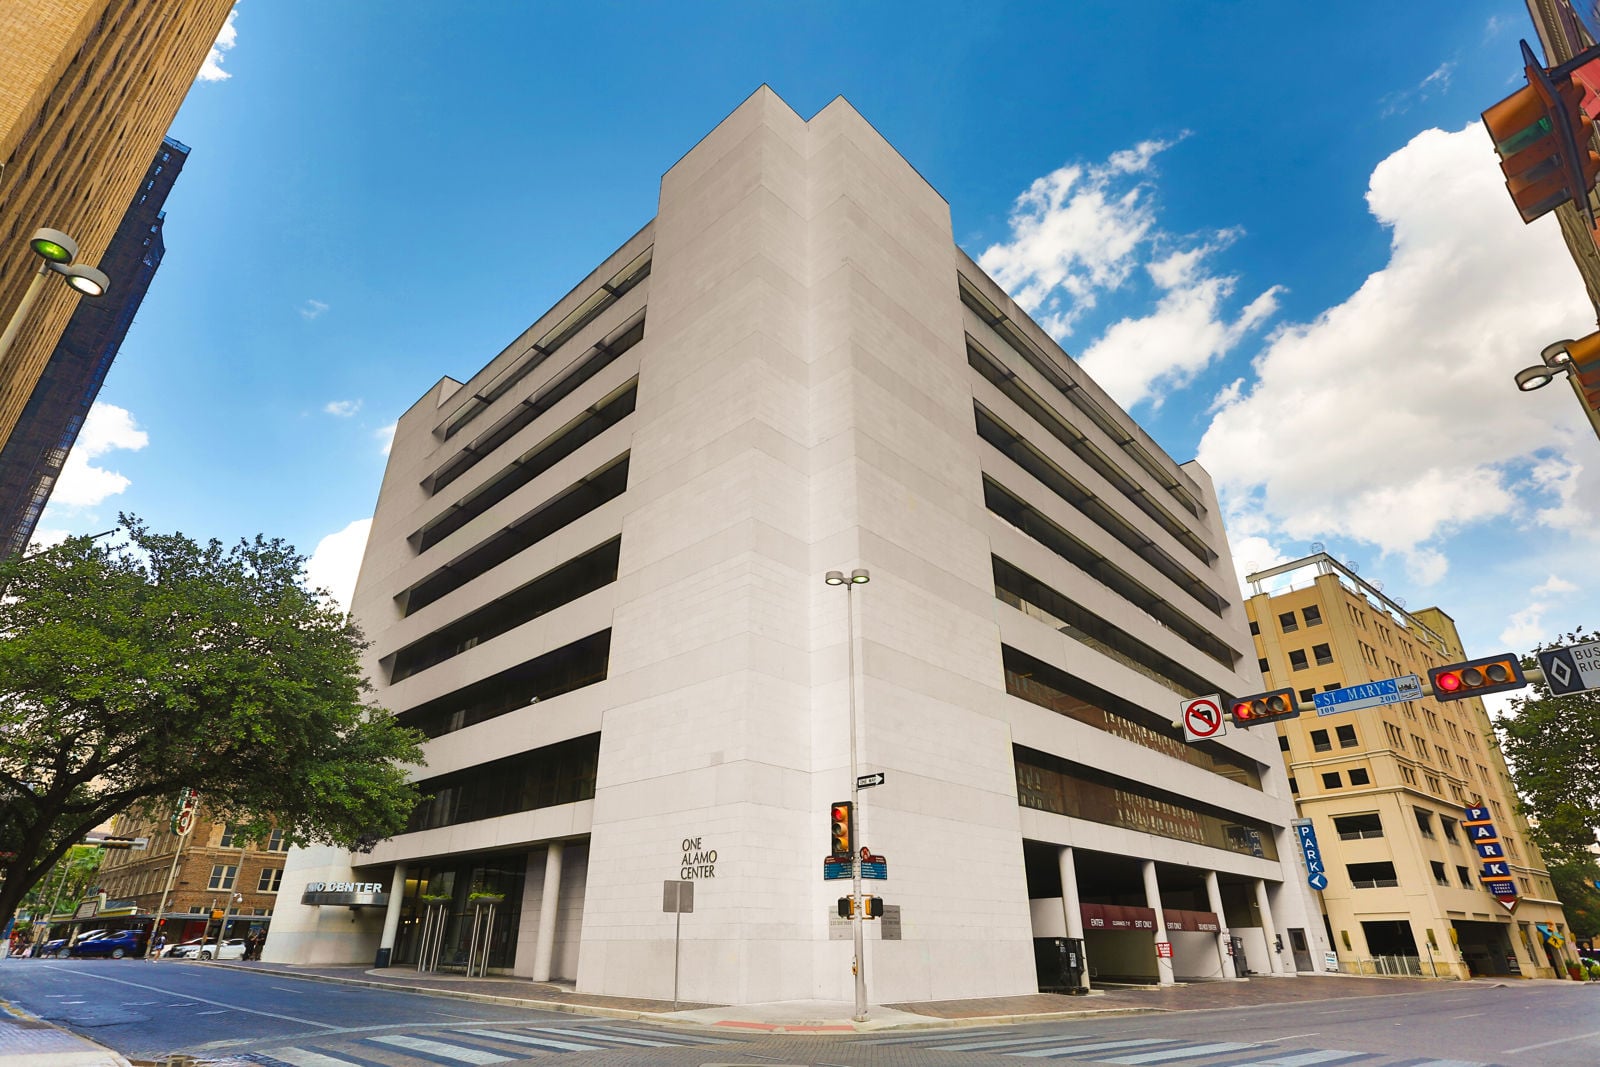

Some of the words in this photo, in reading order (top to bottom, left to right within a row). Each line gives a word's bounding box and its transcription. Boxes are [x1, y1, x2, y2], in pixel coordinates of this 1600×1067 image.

[1574, 646, 1600, 660] BUS
[1323, 691, 1342, 705] ST.
[1346, 680, 1396, 701] MARY'S
[1380, 694, 1397, 704] 200
[1320, 706, 1335, 715] 100
[681, 837, 702, 852] ONE
[1301, 826, 1320, 872] PARK
[1471, 808, 1504, 875] PARK
[681, 850, 718, 866] ALAMO
[680, 864, 716, 880] CENTER
[328, 882, 383, 893] CENTER
